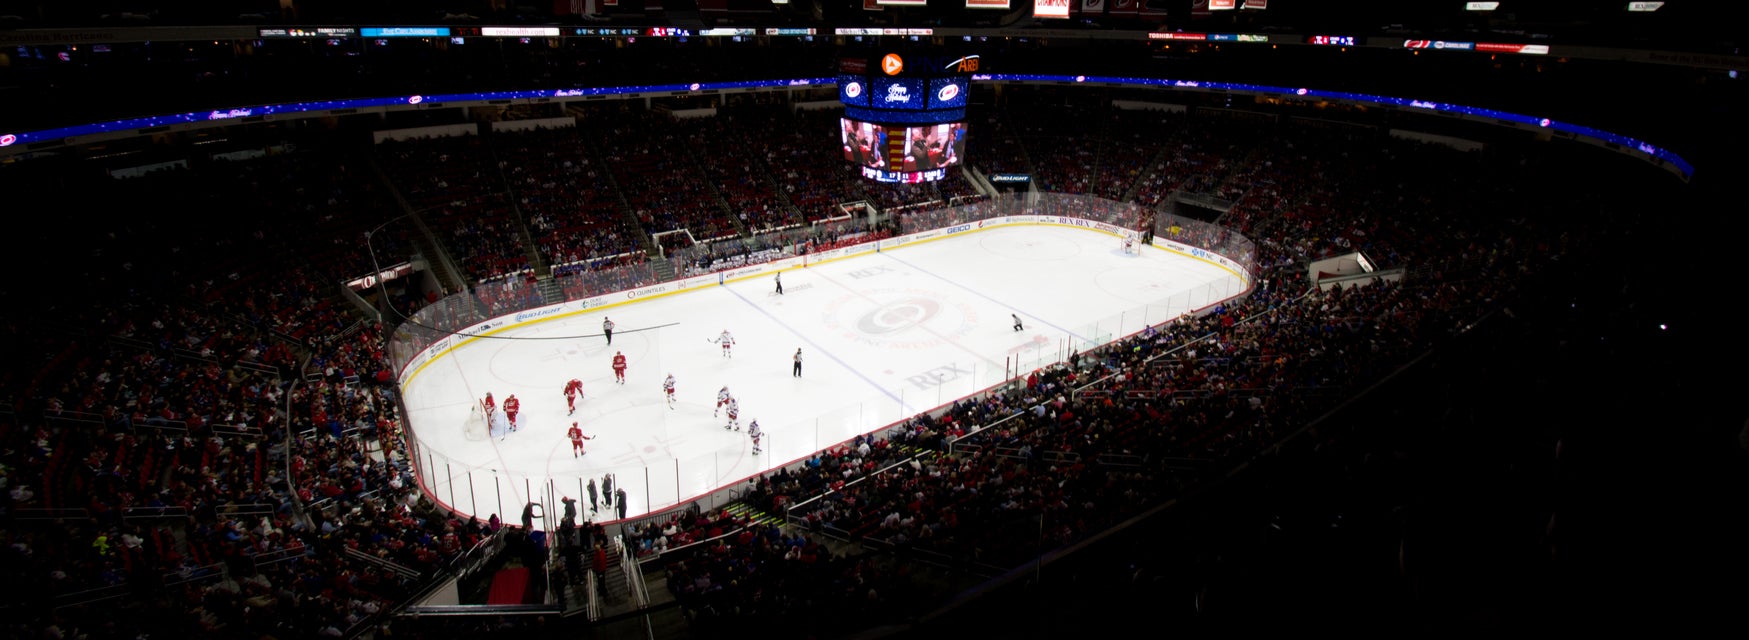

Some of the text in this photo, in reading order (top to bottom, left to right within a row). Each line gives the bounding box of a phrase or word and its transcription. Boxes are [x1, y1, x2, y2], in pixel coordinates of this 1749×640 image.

[947, 224, 971, 235] GEICO
[847, 264, 896, 280] REX
[636, 286, 666, 297] QUINTILES
[904, 362, 972, 391] REX
